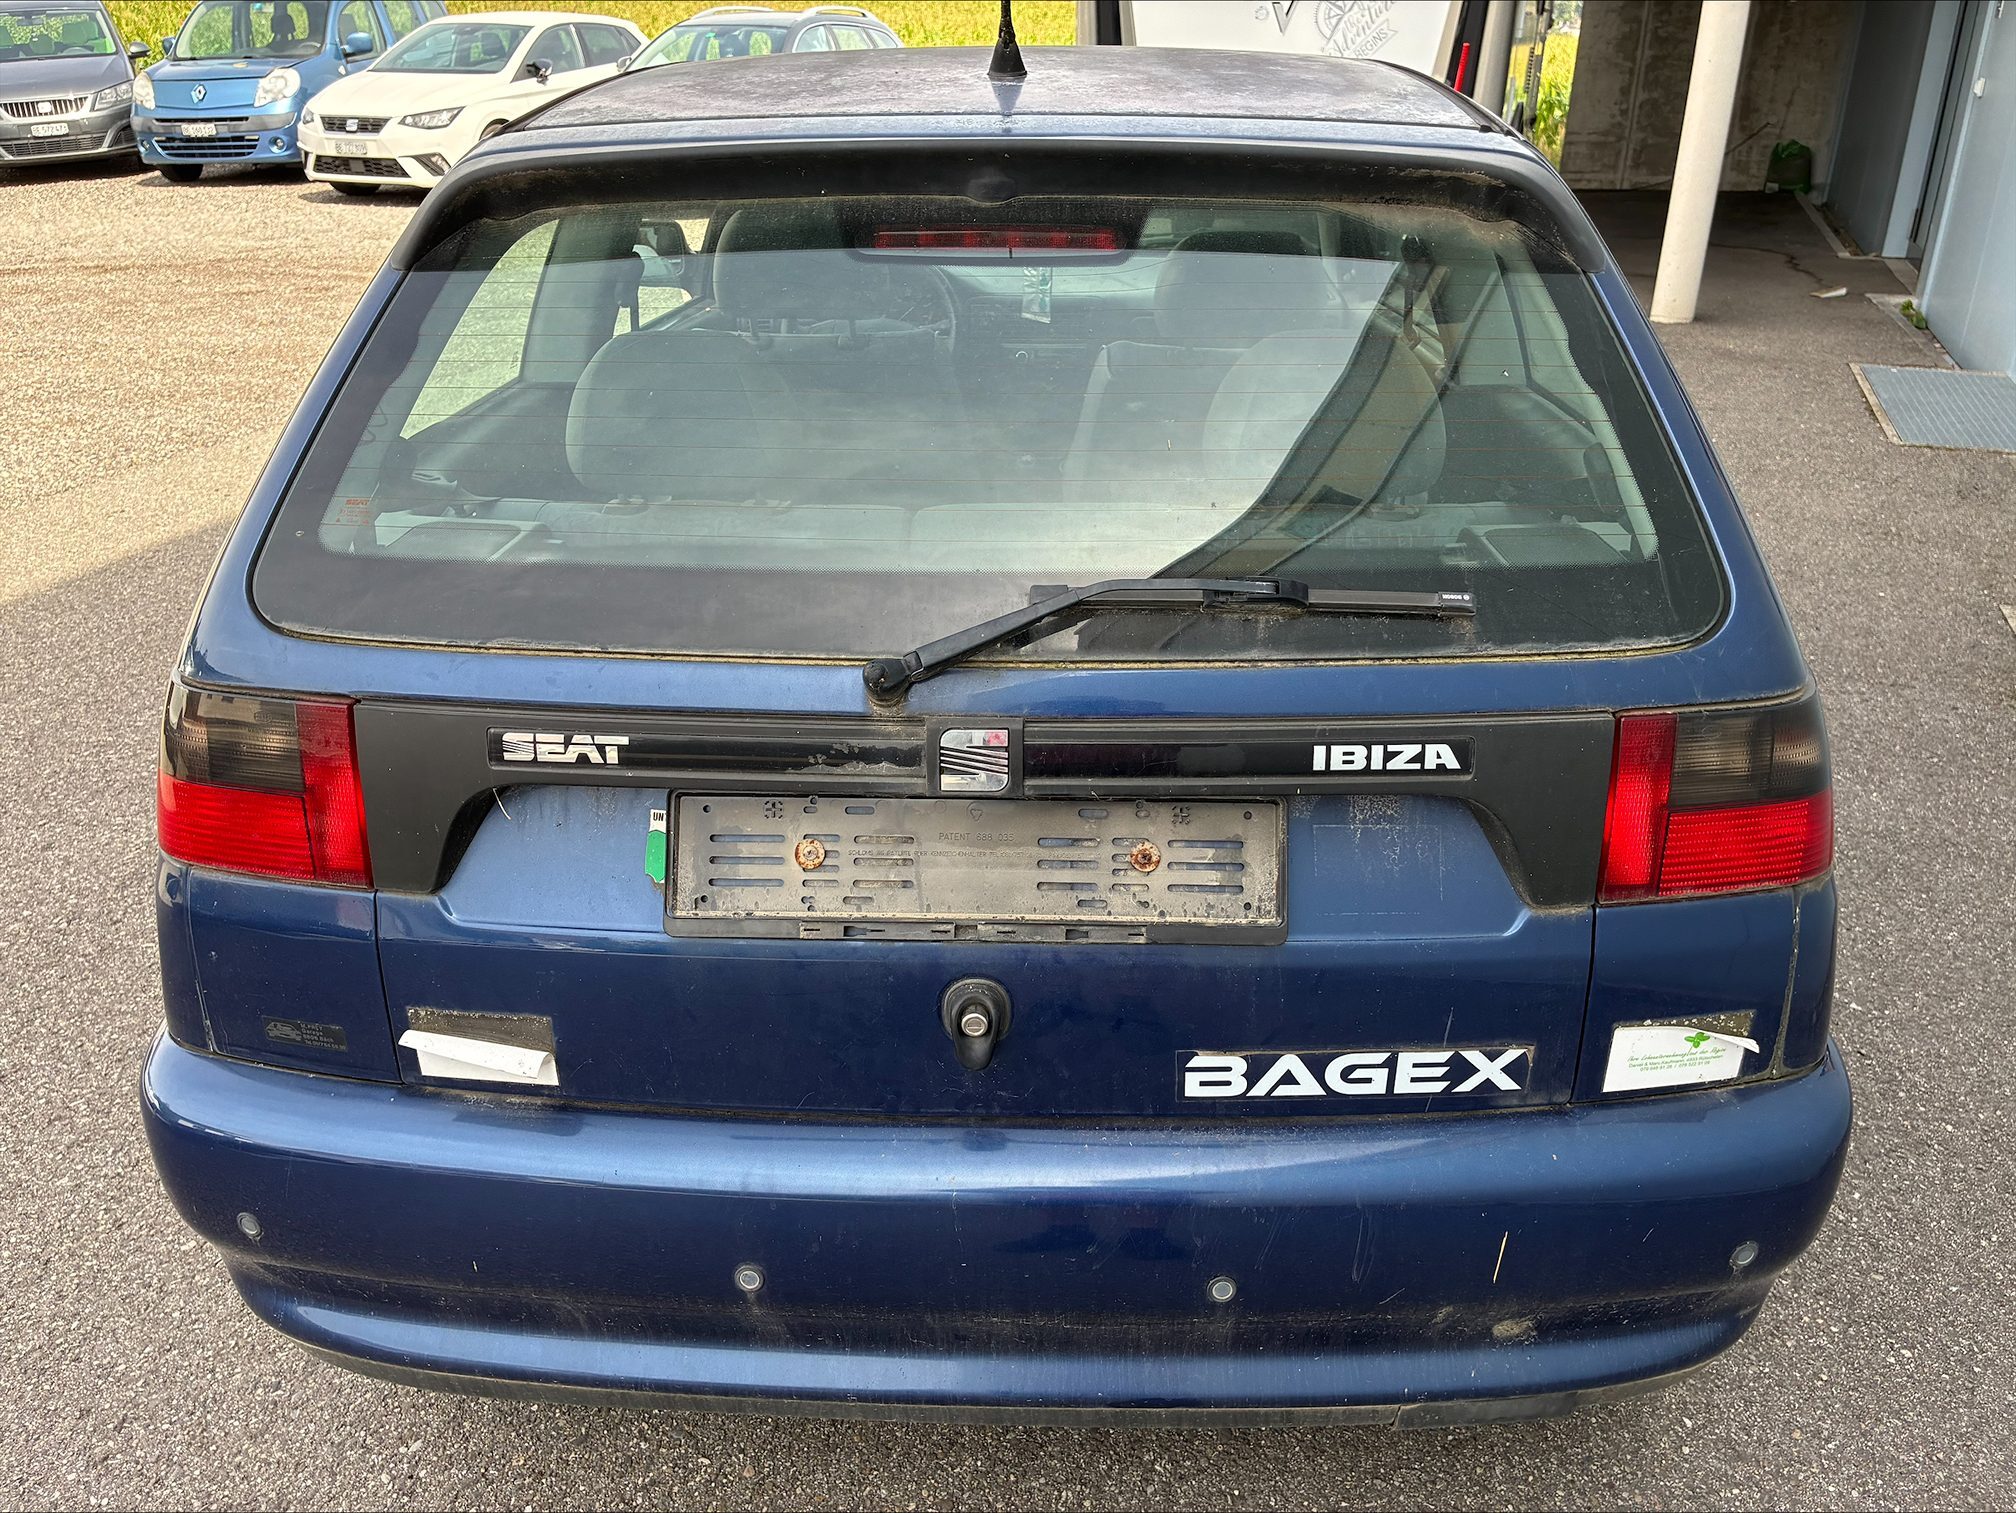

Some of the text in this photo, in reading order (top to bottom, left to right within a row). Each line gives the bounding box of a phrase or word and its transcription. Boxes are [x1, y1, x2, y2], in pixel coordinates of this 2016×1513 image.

[1354, 27, 1388, 58] BEGINS
[502, 732, 629, 764] SEAT
[1312, 744, 1461, 771] IBIZA
[938, 832, 971, 840] PATENT
[976, 832, 992, 841] 688
[1184, 1049, 1528, 1097] BAGEX
